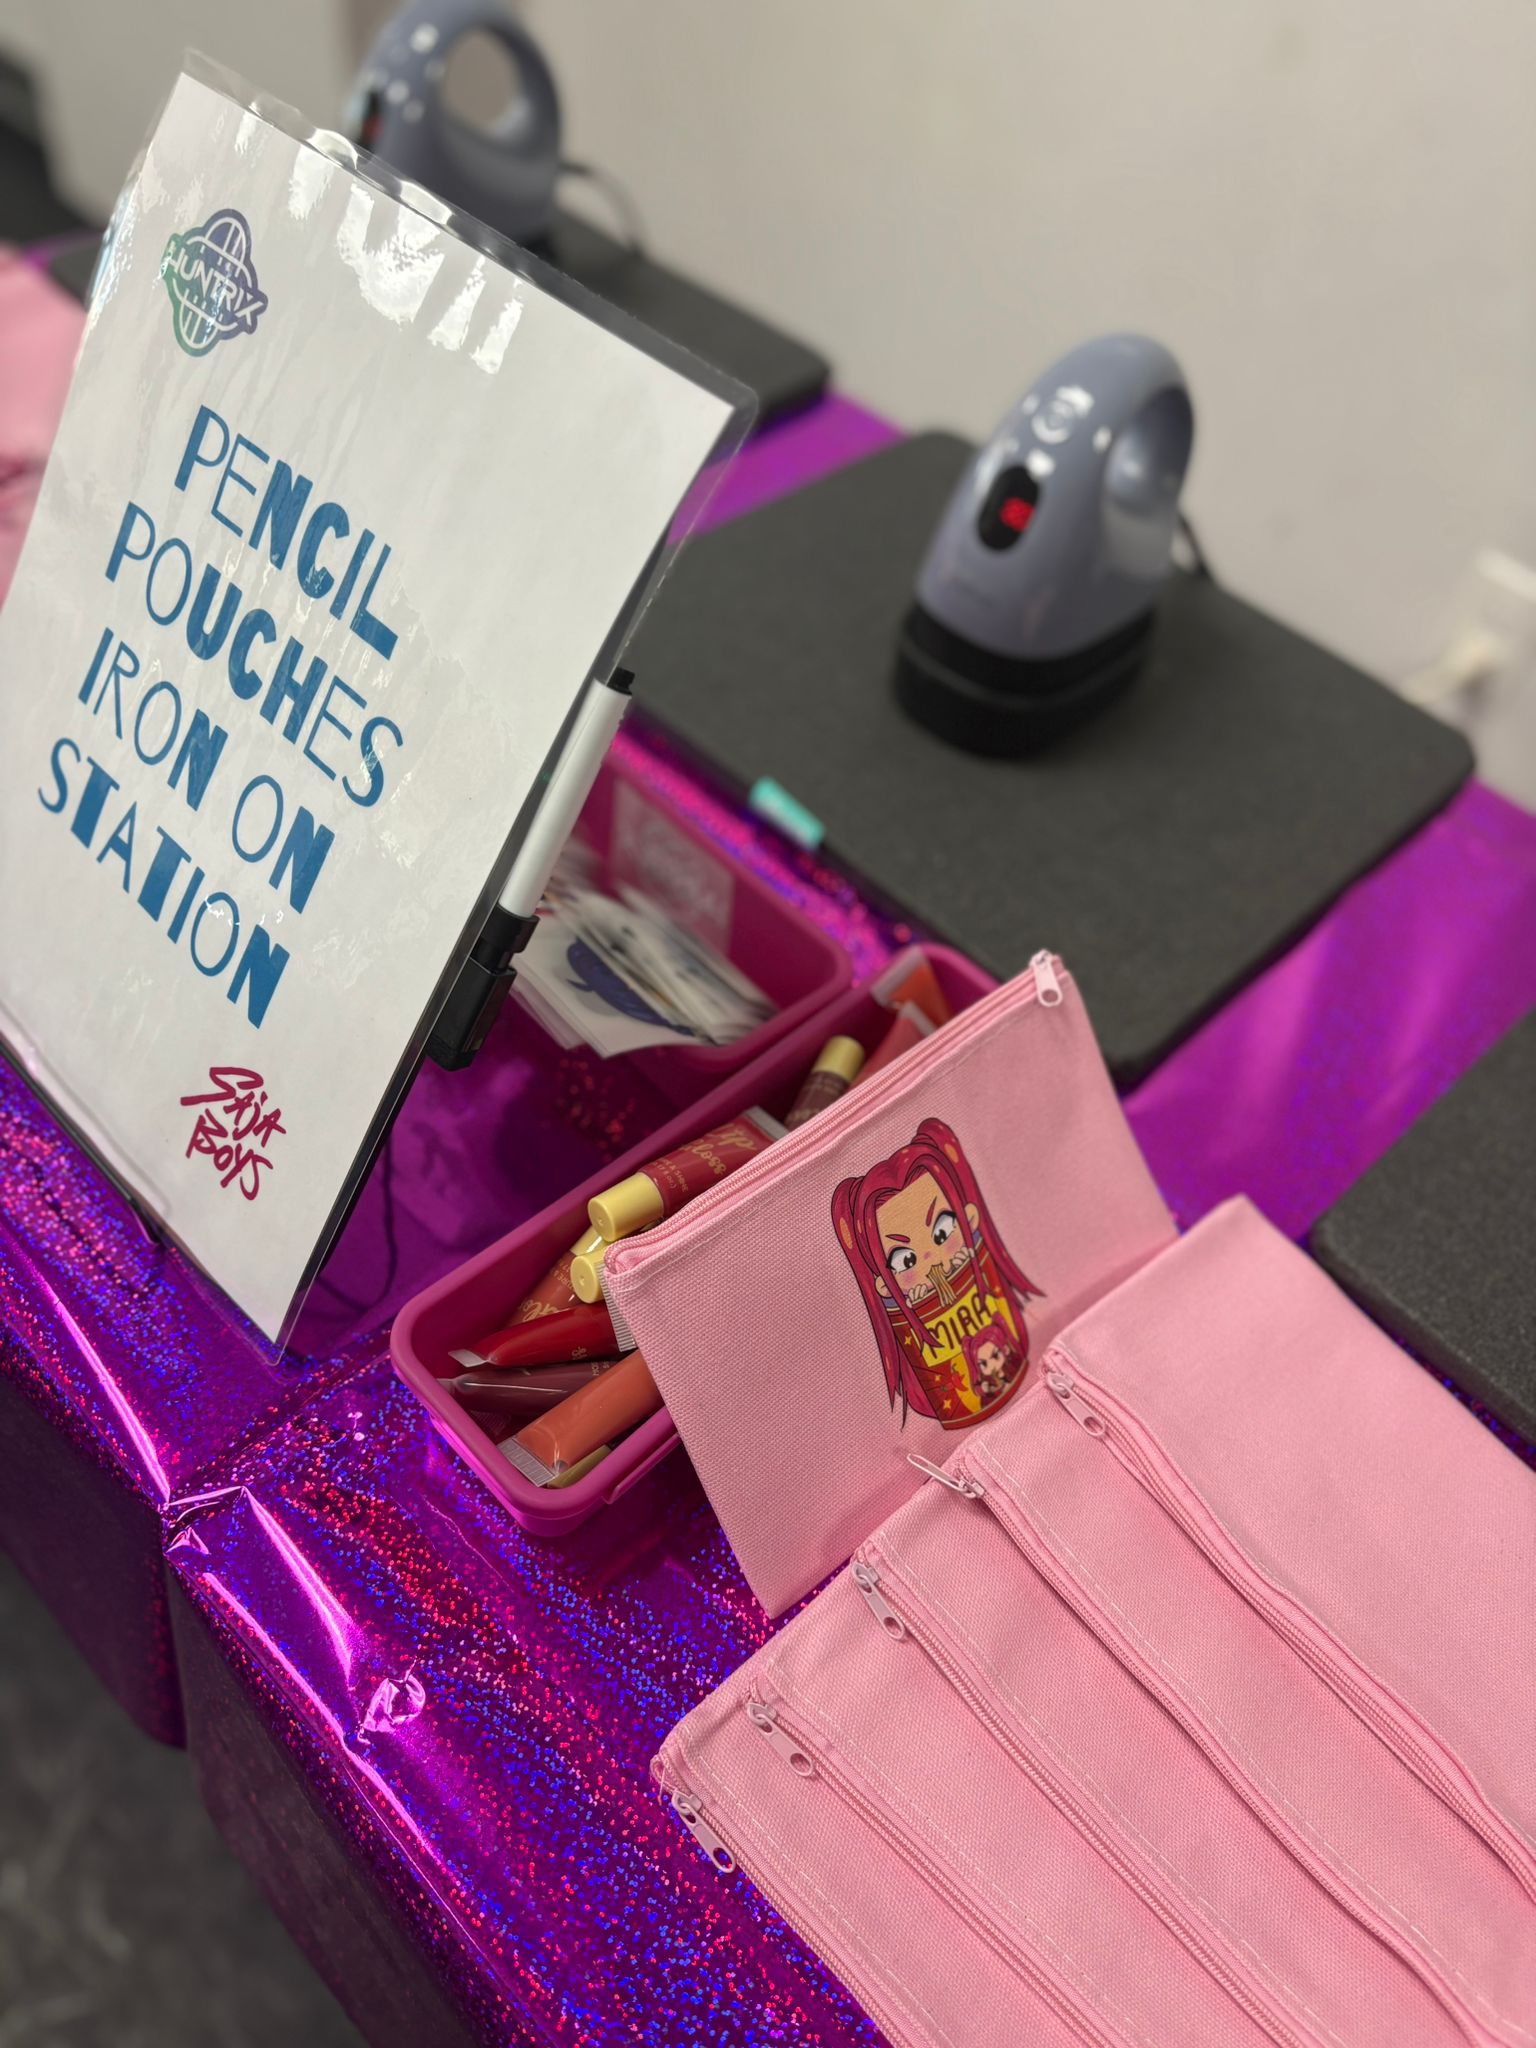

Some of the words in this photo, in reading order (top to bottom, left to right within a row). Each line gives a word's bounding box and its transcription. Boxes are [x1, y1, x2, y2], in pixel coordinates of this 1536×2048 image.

[104, 501, 404, 807] POUCHES
[173, 404, 398, 661] PENCIL
[37, 737, 290, 1030] STATION
[77, 626, 228, 812] IRON
[231, 774, 335, 915] ON
[180, 1066, 287, 1149] SAJA
[185, 1107, 274, 1201] BOYS
